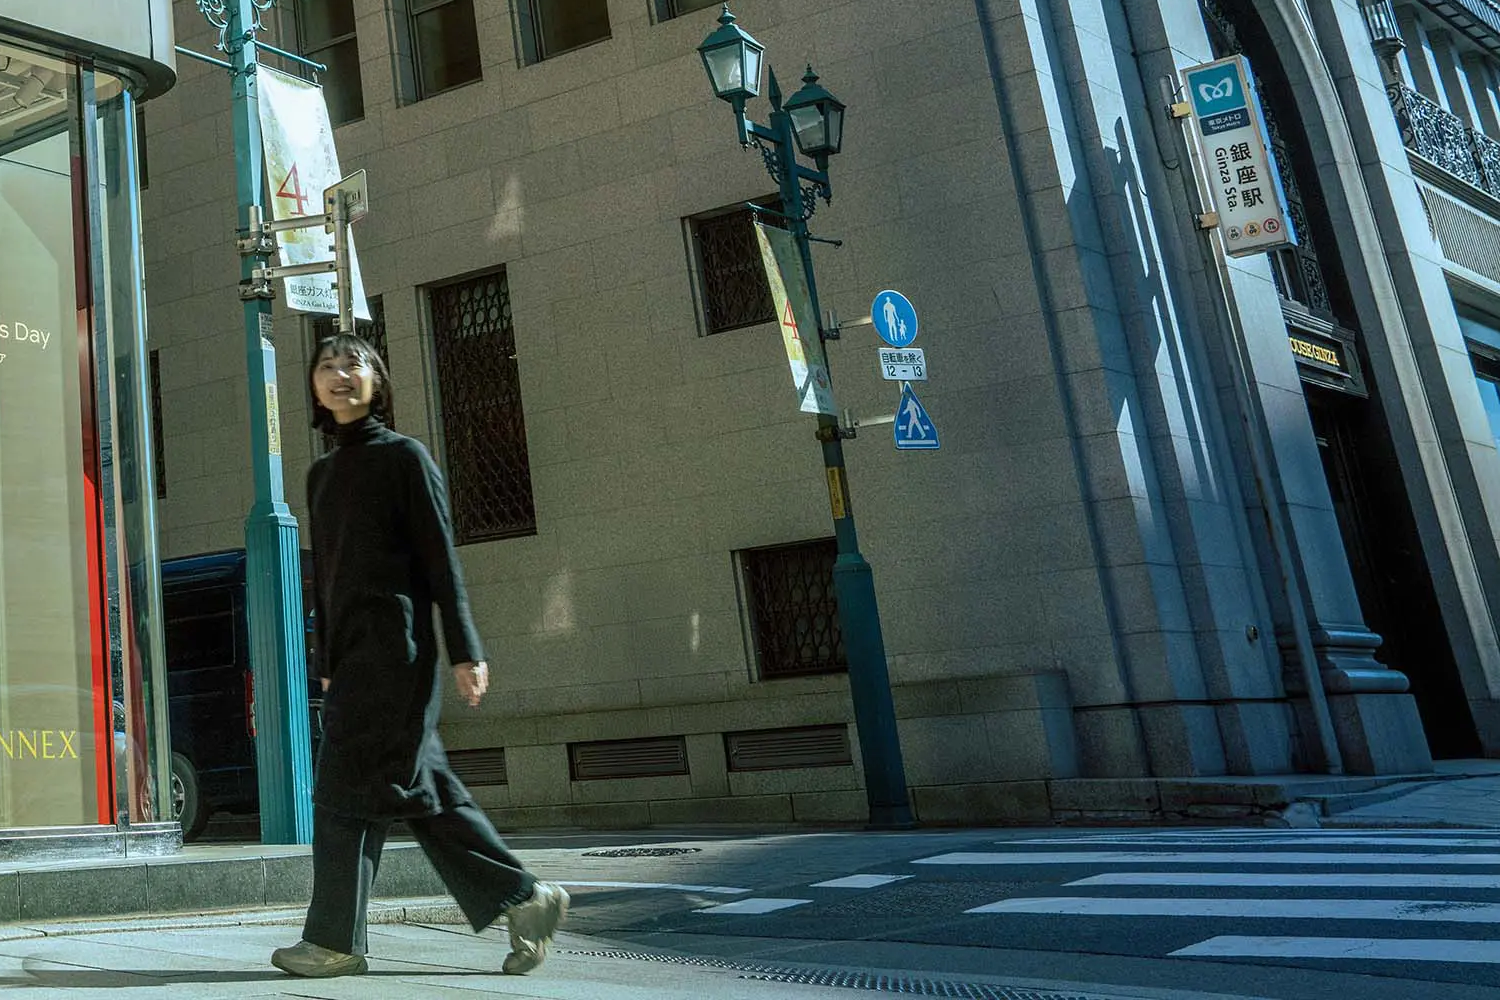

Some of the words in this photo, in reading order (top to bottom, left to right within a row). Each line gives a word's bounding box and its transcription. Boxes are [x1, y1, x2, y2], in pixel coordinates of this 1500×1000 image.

[1214, 147, 1231, 184] Ginza
[1224, 186, 1238, 212] Sta.
[1229, 142, 1264, 208] 銀座駅
[290, 283, 337, 299] 銀座ガス灯
[15, 322, 51, 350] Day
[882, 352, 922, 364] 自転車を除く
[1289, 337, 1313, 358] OUSE
[1312, 344, 1340, 366] GINZA
[886, 366, 896, 377] 12
[912, 366, 923, 377] 13
